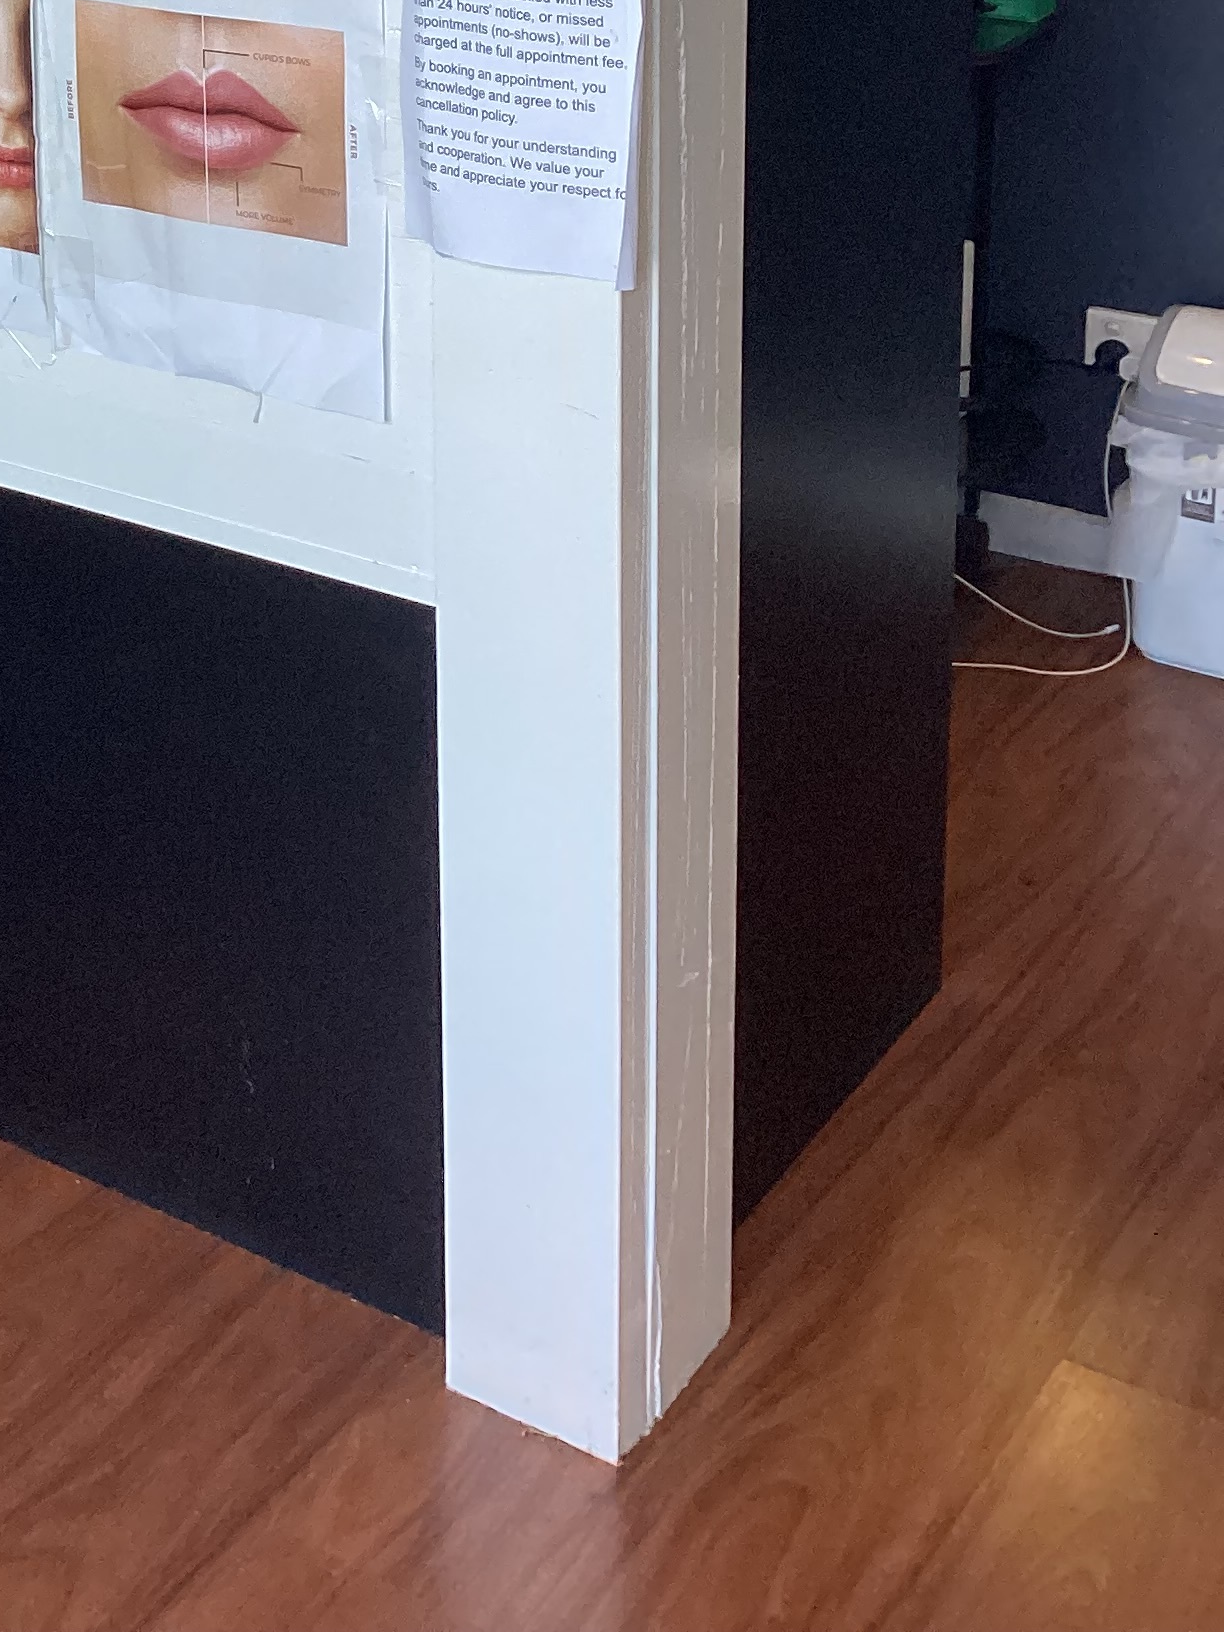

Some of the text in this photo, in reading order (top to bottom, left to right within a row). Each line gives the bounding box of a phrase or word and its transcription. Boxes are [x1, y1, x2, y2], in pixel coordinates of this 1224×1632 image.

[414, 32, 628, 70] charged at the full appointment fee.
[66, 79, 74, 119] BEFORE
[415, 96, 518, 126] cancellation policy.
[350, 124, 358, 159] AFTER
[417, 118, 617, 163] Thank you for your understanding
[510, 156, 605, 179] We value your
